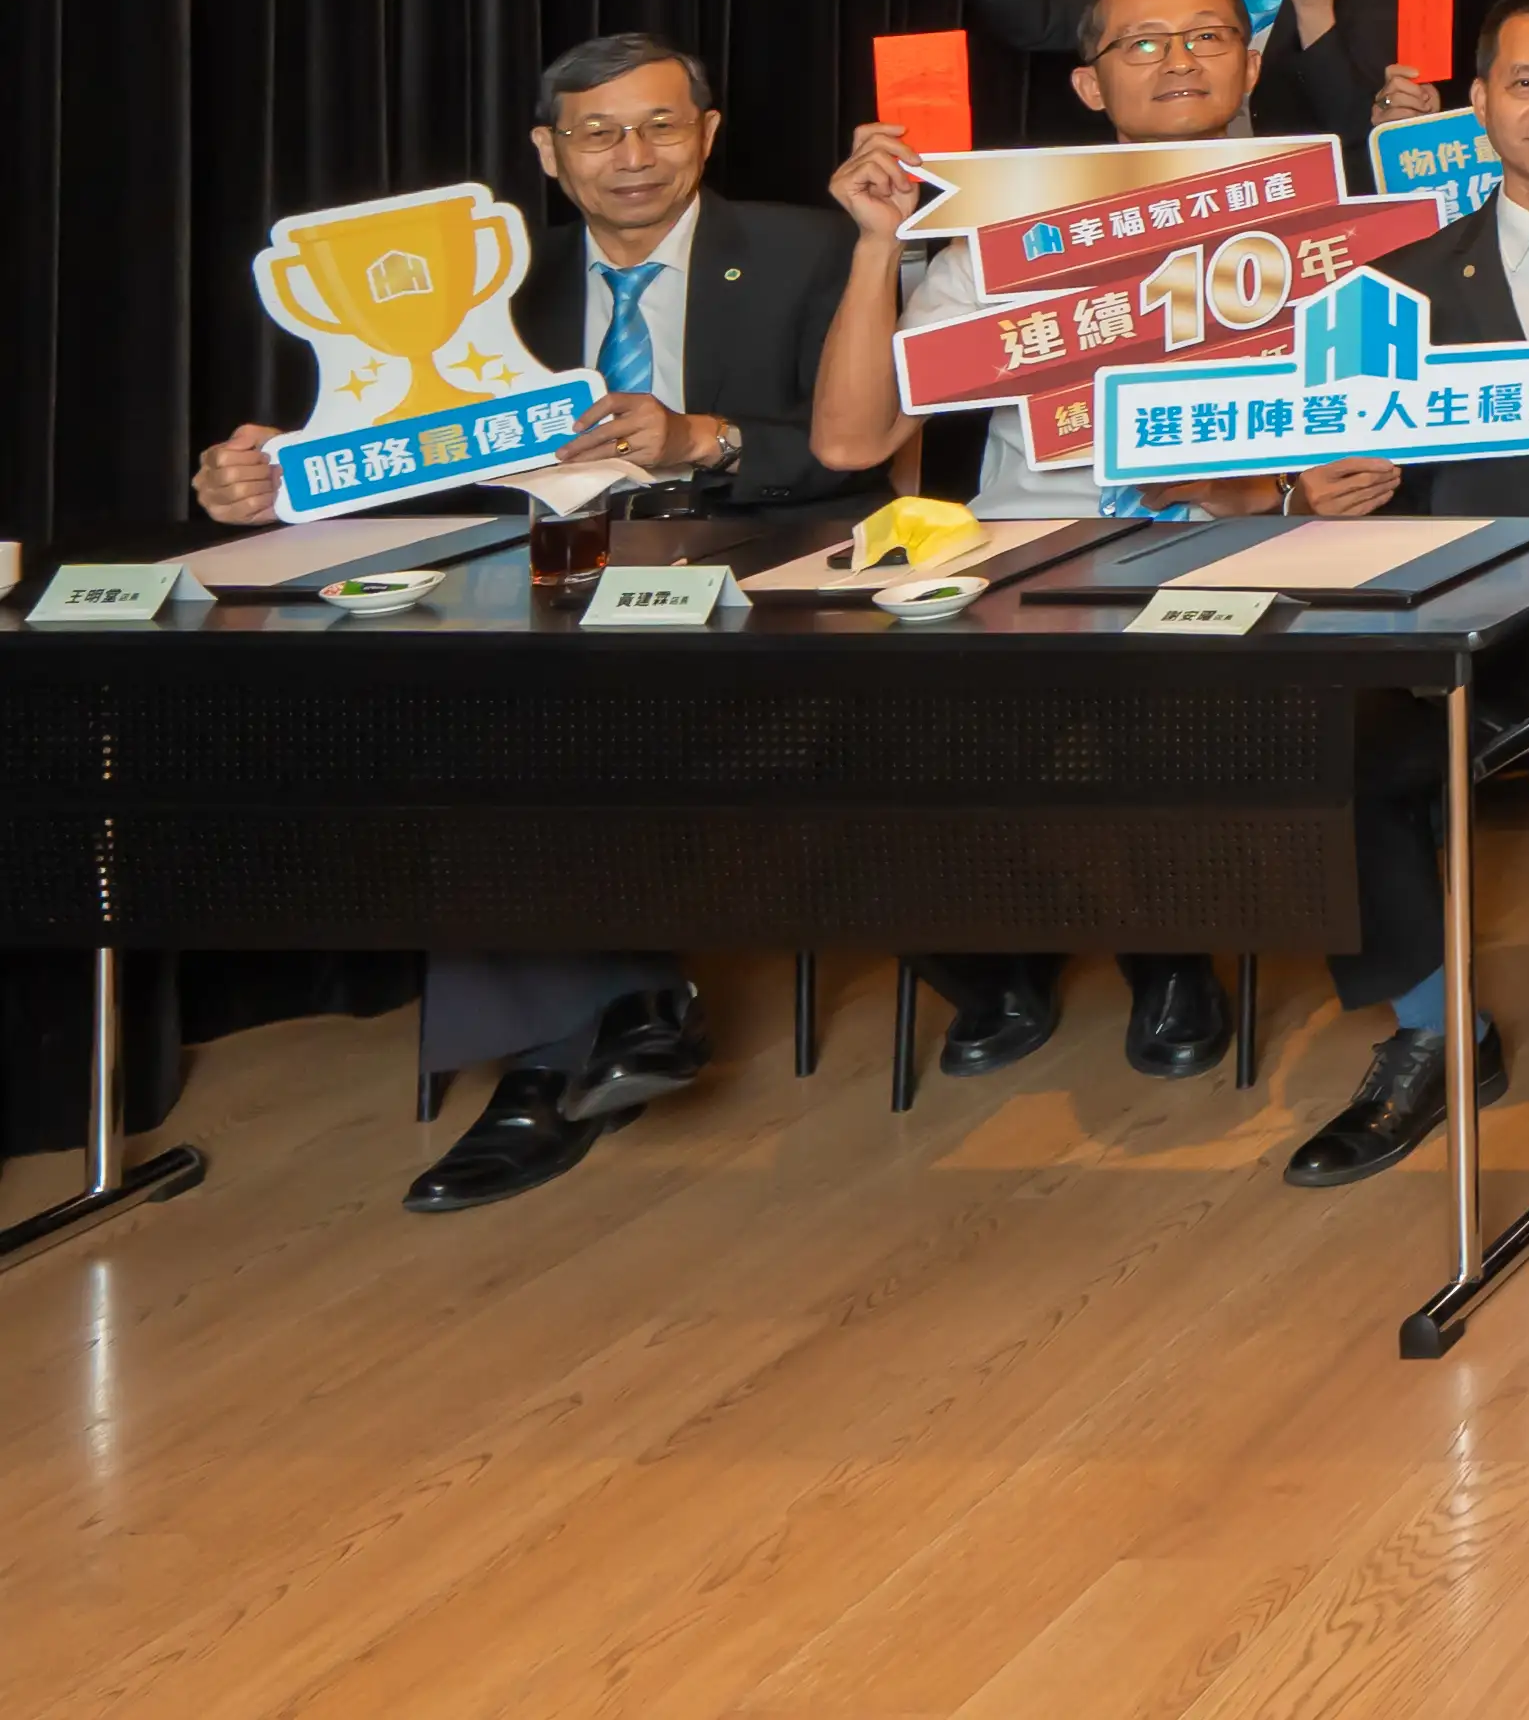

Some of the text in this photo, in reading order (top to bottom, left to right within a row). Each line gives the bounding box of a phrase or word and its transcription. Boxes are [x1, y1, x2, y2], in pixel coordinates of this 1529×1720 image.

[1069, 171, 1296, 247] 幸福家不動產
[999, 230, 1355, 372] 連續10年
[303, 397, 577, 497] 服務最優質
